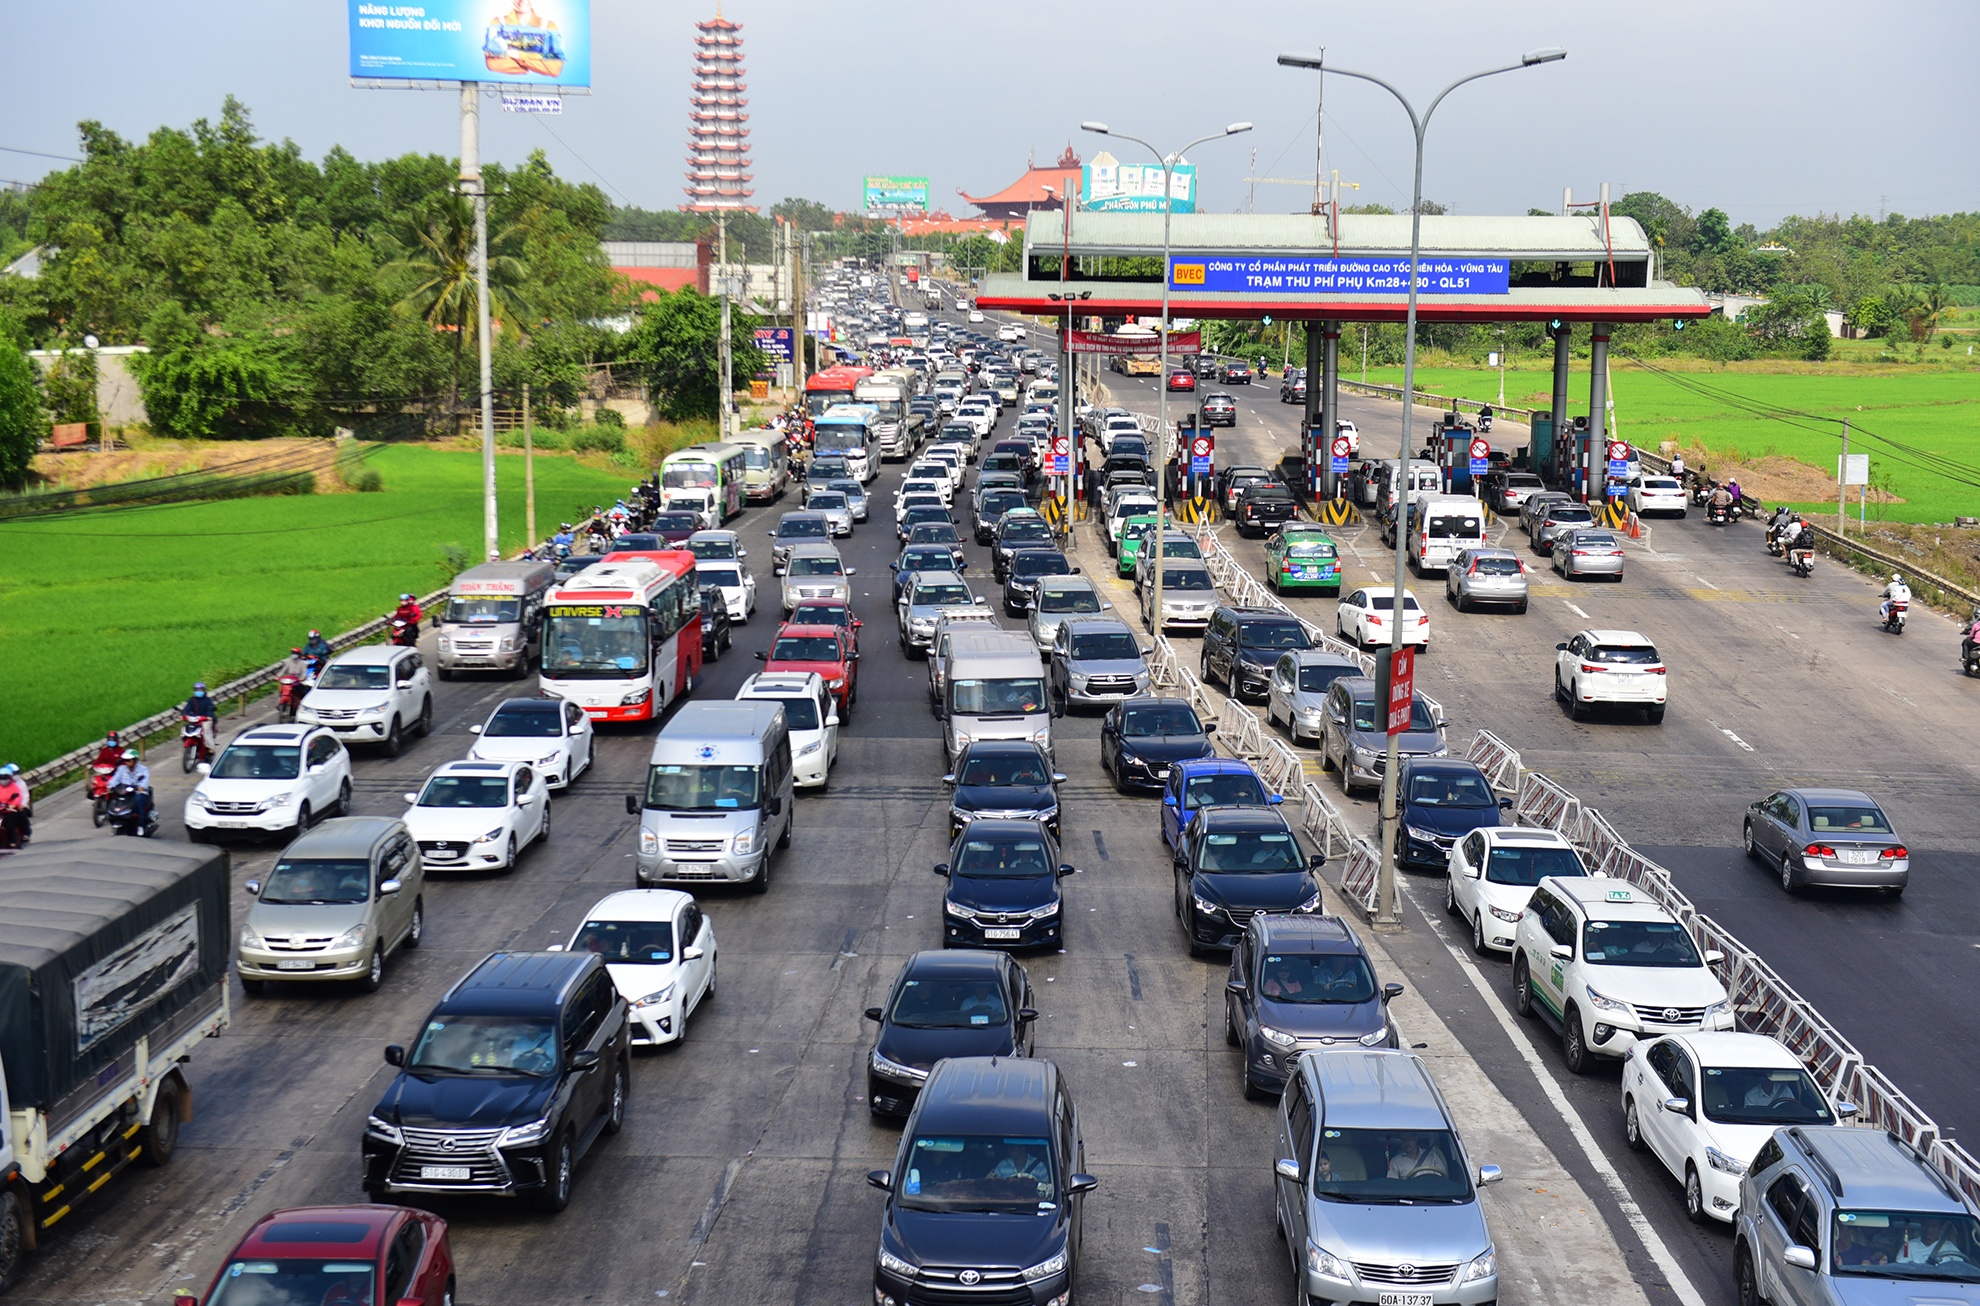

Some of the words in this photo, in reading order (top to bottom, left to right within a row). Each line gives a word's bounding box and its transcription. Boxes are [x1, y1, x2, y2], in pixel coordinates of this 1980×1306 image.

[1209, 261, 1232, 271] CÔNG
[1235, 263, 1246, 271] TY
[1249, 260, 1261, 272] CỔ
[1263, 261, 1285, 272] PHẦN
[1288, 261, 1310, 272] PHÁT
[1314, 261, 1338, 272] TRIỂN
[1340, 262, 1370, 272] ĐƯỜNG
[1372, 264, 1390, 272] CAO
[1393, 262, 1410, 272] TỐC
[1461, 263, 1484, 273] VŨNG
[1487, 263, 1503, 273] TÀU
[1176, 268, 1202, 280] BVEC
[1246, 276, 1282, 288] TRẠM
[1286, 276, 1310, 287] THU
[1314, 274, 1334, 287] PHÍ
[1338, 277, 1362, 290] PHỤ
[1367, 277, 1429, 288] Km28+80
[1440, 278, 1470, 288] QL51
[1381, 1295, 1431, 1306] 60A-137.37
